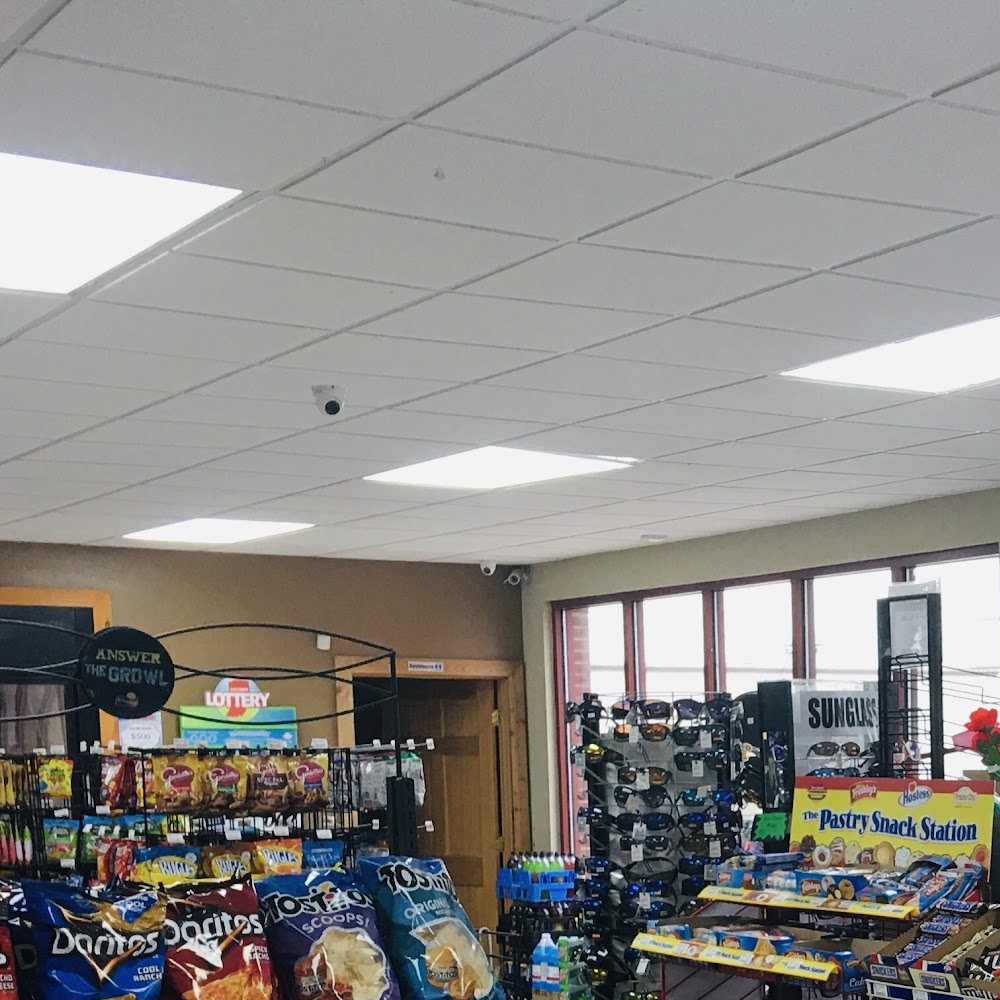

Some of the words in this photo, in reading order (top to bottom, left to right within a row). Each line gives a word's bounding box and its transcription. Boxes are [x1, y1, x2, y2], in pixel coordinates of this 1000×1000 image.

[95, 648, 160, 665] ANSWER
[85, 663, 107, 677] THE
[109, 666, 168, 686] GROWL
[205, 691, 270, 708] LOTTERY
[903, 790, 929, 803] Hostess
[802, 811, 819, 820] The
[819, 809, 869, 834] Pastry
[870, 811, 917, 838] Snack
[919, 818, 977, 841] Station
[163, 912, 263, 945] Doritos
[302, 913, 370, 934] SCOOPS!
[53, 927, 160, 956] Doritos
[133, 973, 162, 982] RANCH
[138, 966, 160, 974] COOL
